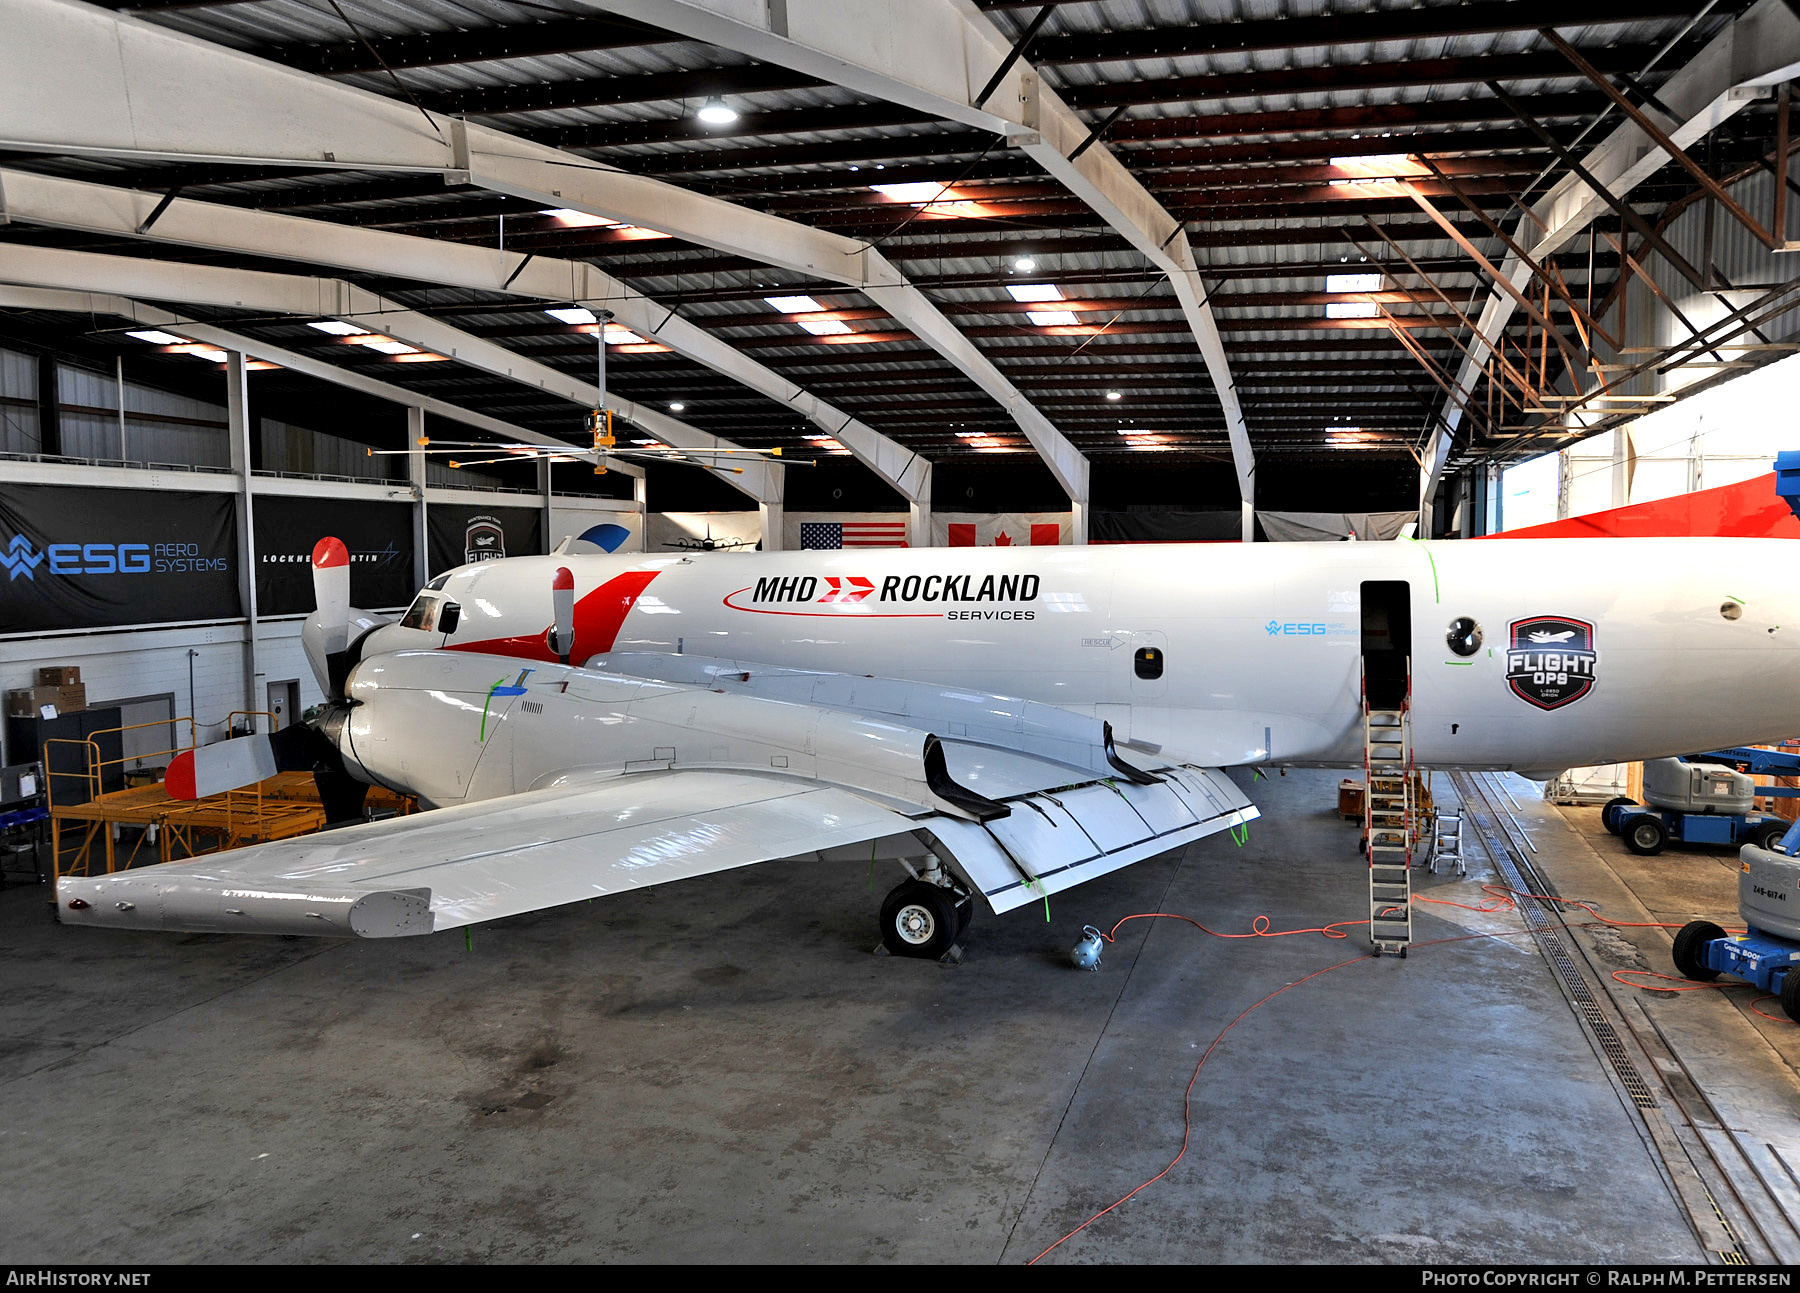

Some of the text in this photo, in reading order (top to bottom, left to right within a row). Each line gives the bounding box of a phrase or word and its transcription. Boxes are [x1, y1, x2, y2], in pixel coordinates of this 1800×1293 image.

[154, 543, 199, 557] AERO
[48, 543, 150, 575] ESG
[155, 557, 228, 573] SYSTEMS
[262, 554, 378, 563] LOCKHE RTIN
[752, 574, 1040, 603] MHD ROCKLAND
[947, 610, 1036, 621] SERVICES
[1283, 623, 1326, 635] ESG
[1509, 654, 1595, 673] FLIGHT
[1533, 672, 1568, 685] OPS
[1723, 942, 1740, 954] Genie
